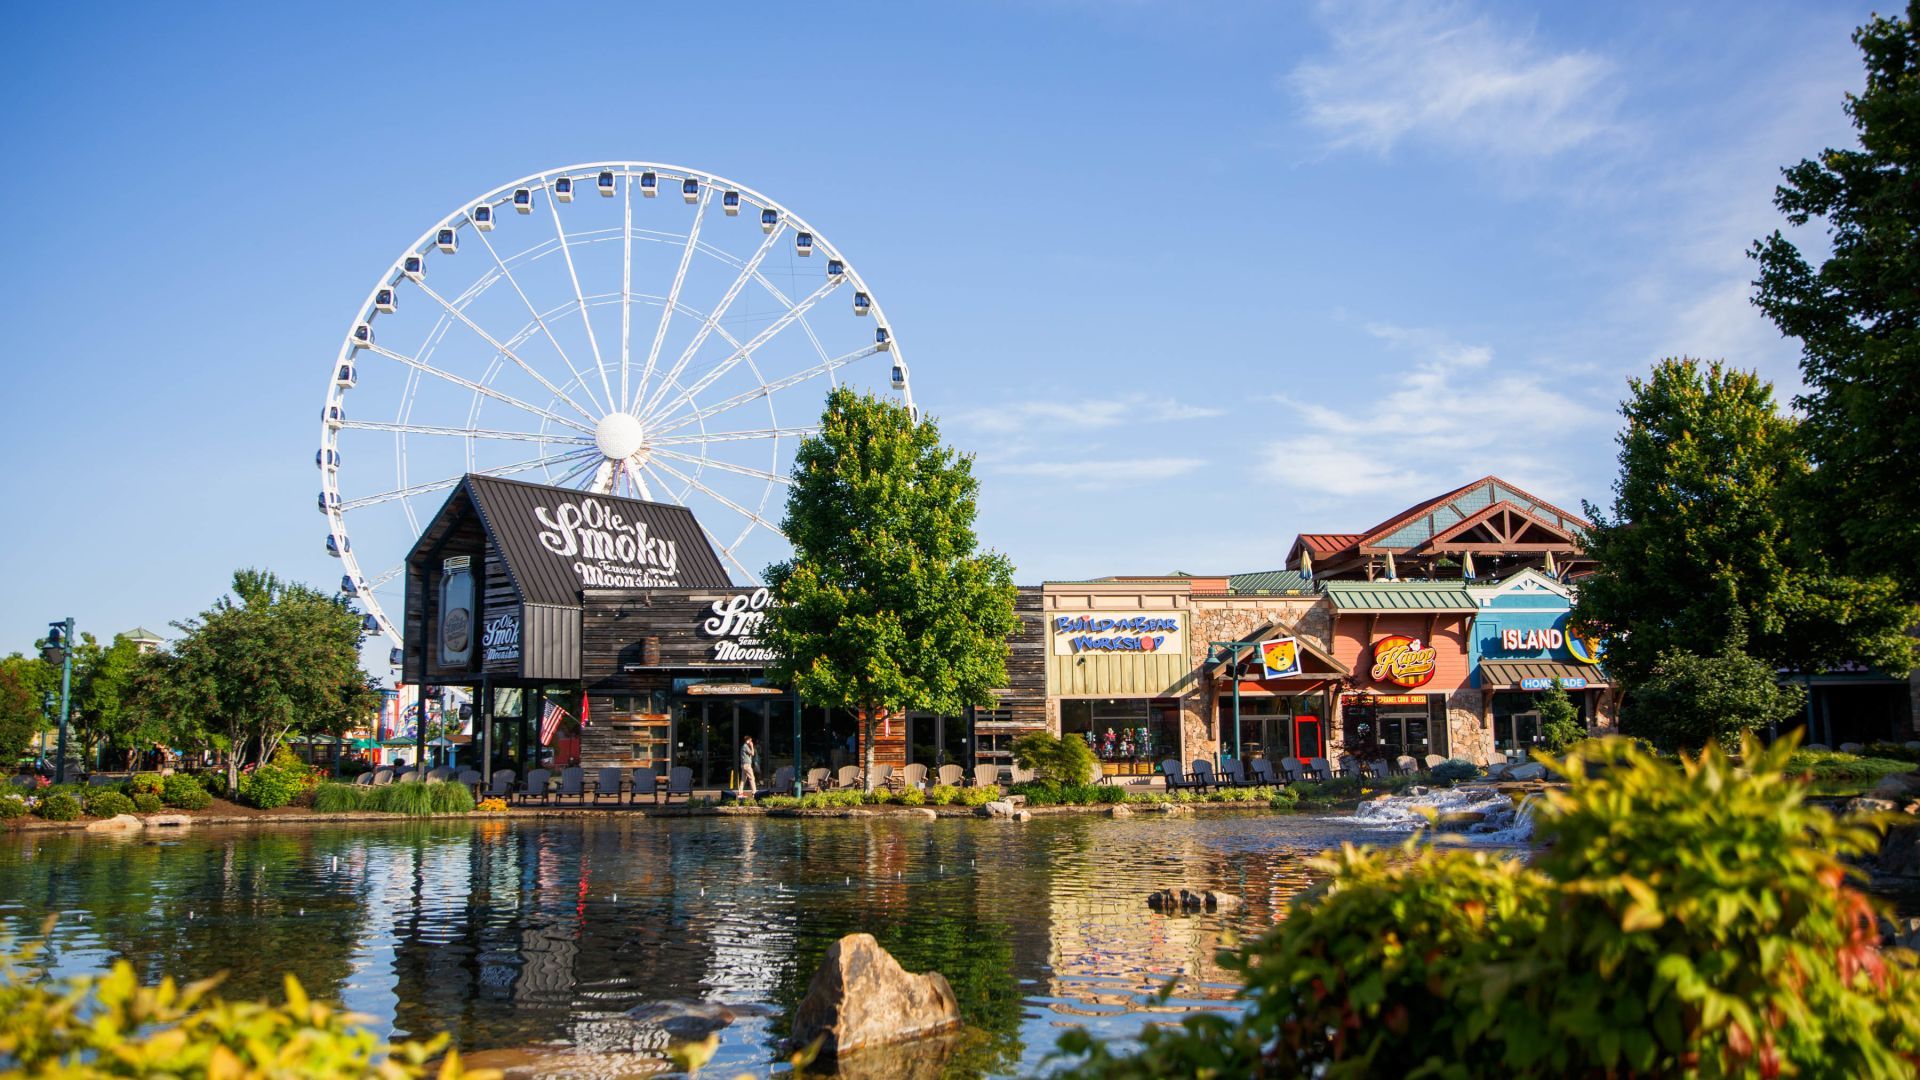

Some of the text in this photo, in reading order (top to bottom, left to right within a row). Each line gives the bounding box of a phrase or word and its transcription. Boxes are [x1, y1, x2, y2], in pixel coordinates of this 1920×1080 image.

[581, 498, 635, 535] Ole
[535, 503, 680, 576] Smoky
[482, 620, 519, 646] Smok
[1074, 635, 1164, 650] WORKSHOP
[1502, 629, 1563, 650] ISLAND
[714, 640, 774, 660] Moons
[1372, 645, 1435, 679] Kapop
[1525, 679, 1583, 689] HOMADE
